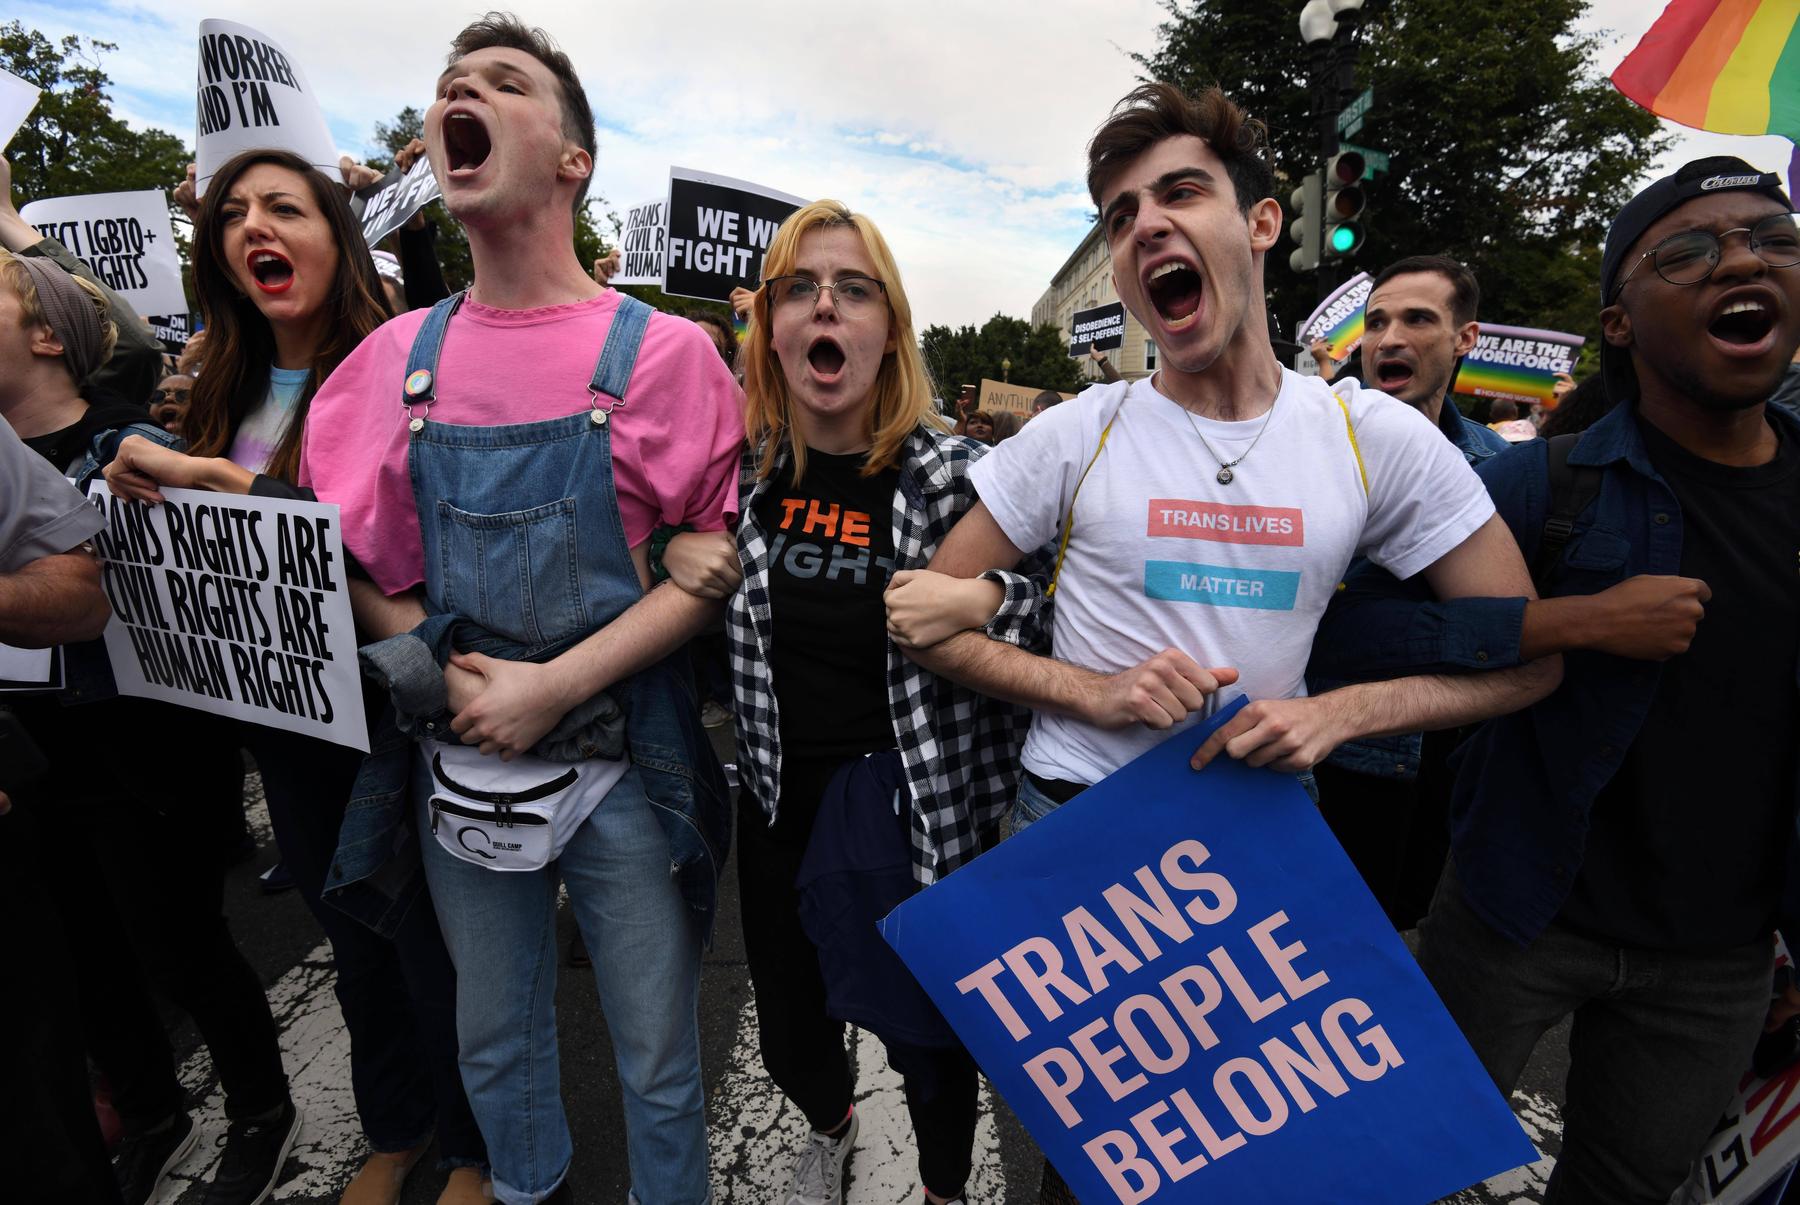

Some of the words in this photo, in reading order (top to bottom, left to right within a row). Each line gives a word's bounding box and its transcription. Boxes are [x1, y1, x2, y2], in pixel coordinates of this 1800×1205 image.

[200, 33, 303, 94] WORKER
[232, 81, 280, 128] I'M
[627, 203, 662, 230] TRANS
[697, 206, 740, 242] WE
[85, 217, 156, 257] LGBTQ+
[625, 228, 651, 252] CIVIL
[79, 254, 148, 290] IGHTS
[625, 252, 662, 278] HUMA
[668, 237, 753, 279] FIGHT
[1075, 314, 1121, 334] DISOBEDIENCE
[1078, 325, 1124, 343] SELF-DEFENSE
[1468, 347, 1573, 374] WORKFORCE
[1476, 335, 1500, 350] WE
[1500, 338, 1536, 355] ARE
[1536, 342, 1571, 360] THE
[780, 499, 870, 547] THE
[1160, 510, 1230, 531] TRANS
[1233, 516, 1294, 535] LIVES
[90, 492, 165, 567] RANS
[164, 501, 269, 582] RIGHTS
[277, 513, 337, 592] ARE
[1180, 574, 1265, 597] MATTER
[104, 561, 170, 631] CIVIL
[165, 568, 272, 648] RIGHTS
[274, 585, 334, 662] ARE
[127, 625, 234, 702] HUMAN
[229, 643, 335, 724] RIGHTS
[955, 839, 1238, 1042] TRANS
[1022, 910, 1330, 1128] PEOPLE
[1082, 997, 1405, 1205] BELONG
